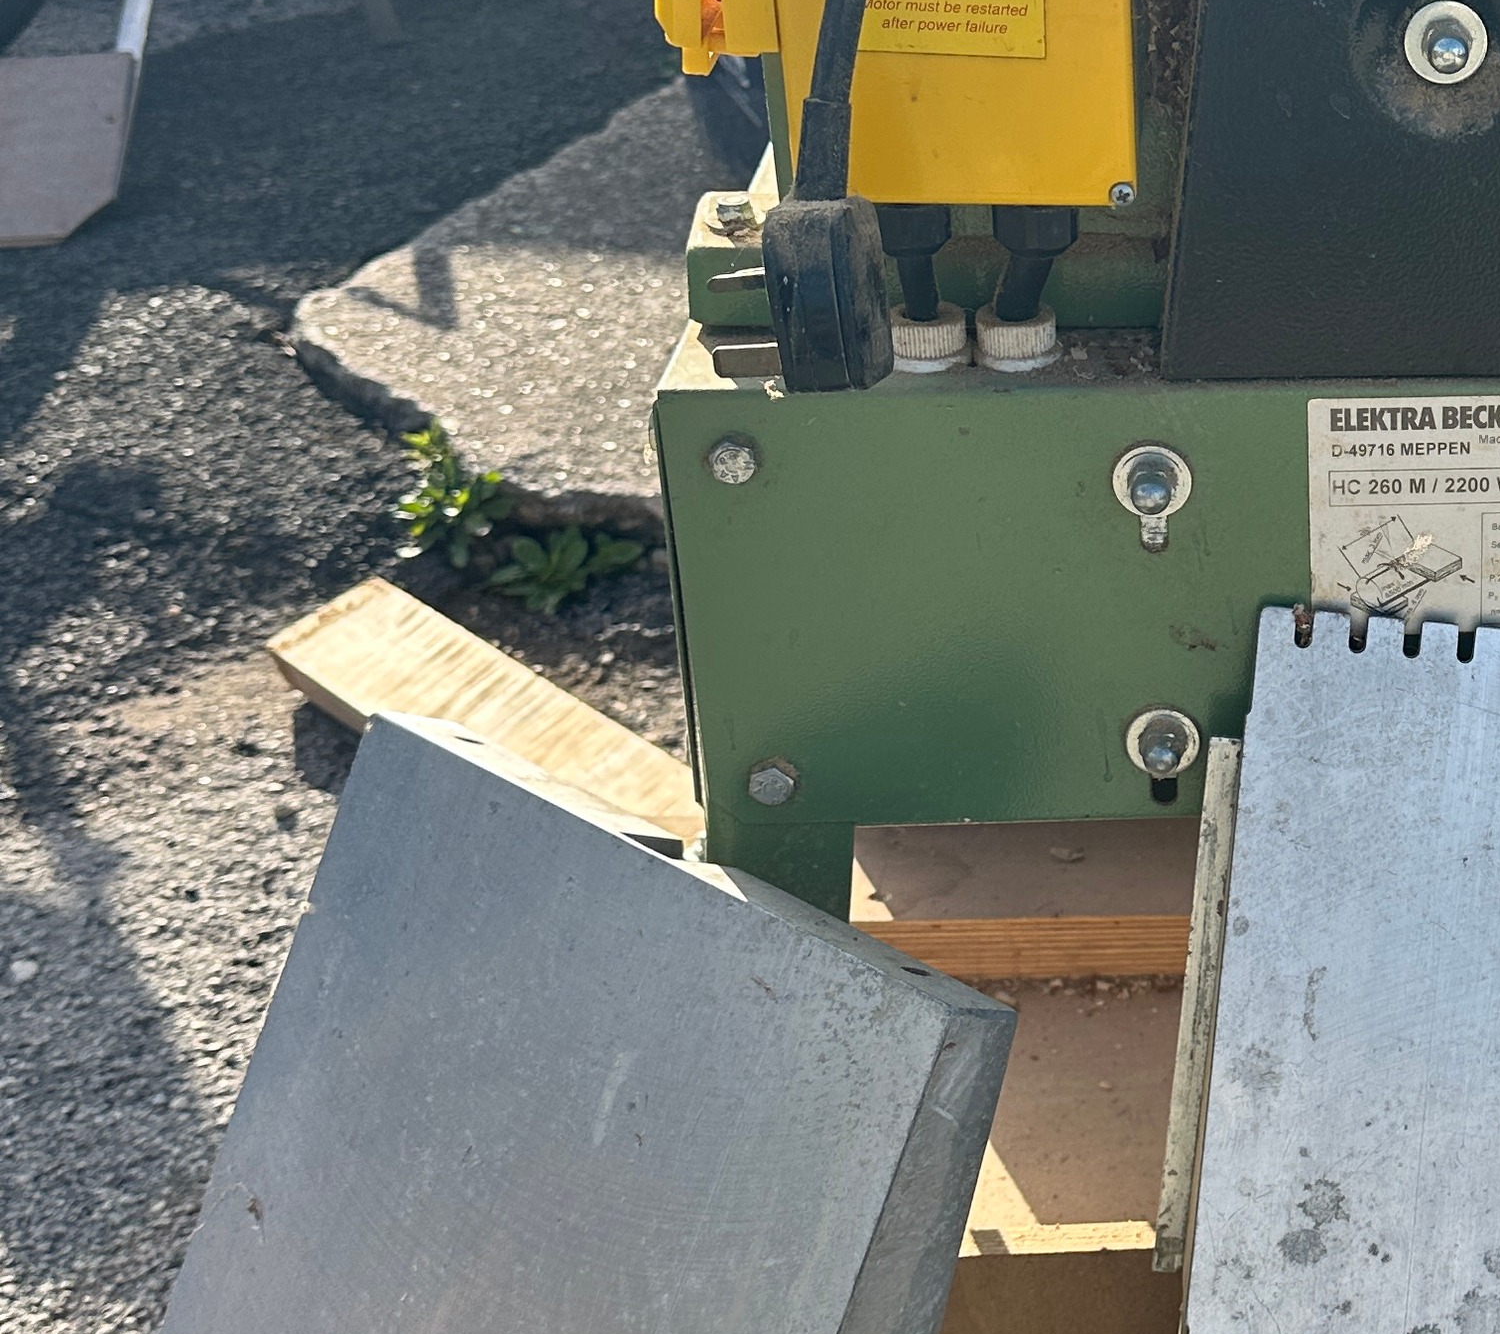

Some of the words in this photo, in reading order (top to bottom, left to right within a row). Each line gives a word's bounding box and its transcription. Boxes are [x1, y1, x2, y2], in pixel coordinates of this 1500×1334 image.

[905, 0, 939, 13] must
[944, 2, 961, 14] be
[966, 3, 1028, 16] restarted
[881, 16, 914, 30] after
[917, 19, 961, 33] power
[965, 20, 1008, 34] failure
[1330, 407, 1436, 431] ELEKTRA
[1331, 443, 1394, 457] D-49716
[1400, 441, 1470, 455] MEPPEN
[1332, 479, 1360, 495] HC
[1369, 479, 1402, 495] 260
[1410, 478, 1426, 493] M
[1432, 477, 1438, 493] /
[1445, 476, 1490, 493] 2200
